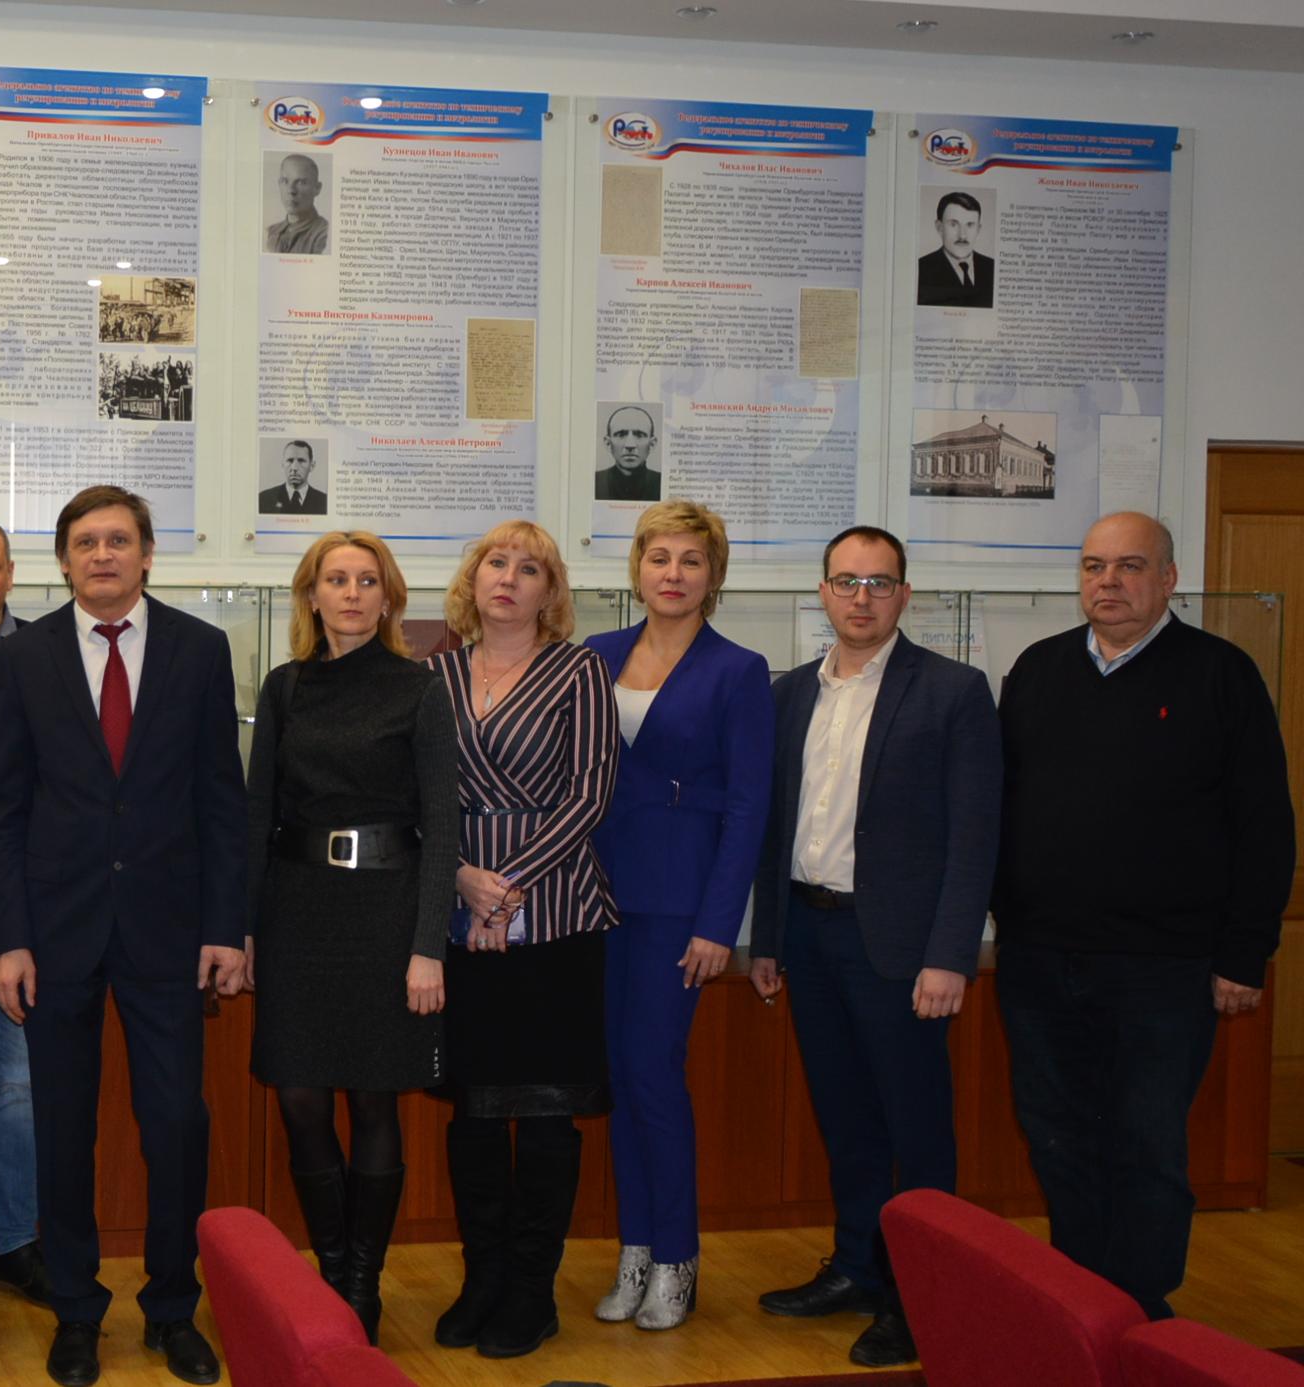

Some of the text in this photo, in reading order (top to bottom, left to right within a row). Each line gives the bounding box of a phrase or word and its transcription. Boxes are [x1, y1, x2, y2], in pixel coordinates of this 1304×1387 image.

[27, 130, 162, 144] Привалов Иван Николаевич
[383, 146, 498, 158] Кузнецов Иван Иванович
[758, 163, 777, 172] Влас
[780, 164, 823, 174] Иванович
[1066, 178, 1087, 187] Иван
[1089, 179, 1139, 190] Николаевич
[636, 277, 752, 289] Карпов Алексей Иванович
[288, 308, 434, 322] Уткина Виктория Казимировна
[690, 401, 833, 413] Землянский Андрей Михайлович
[371, 436, 502, 448] Николаев Алексей Петрович
[921, 632, 975, 644] ДИПЛОМ
